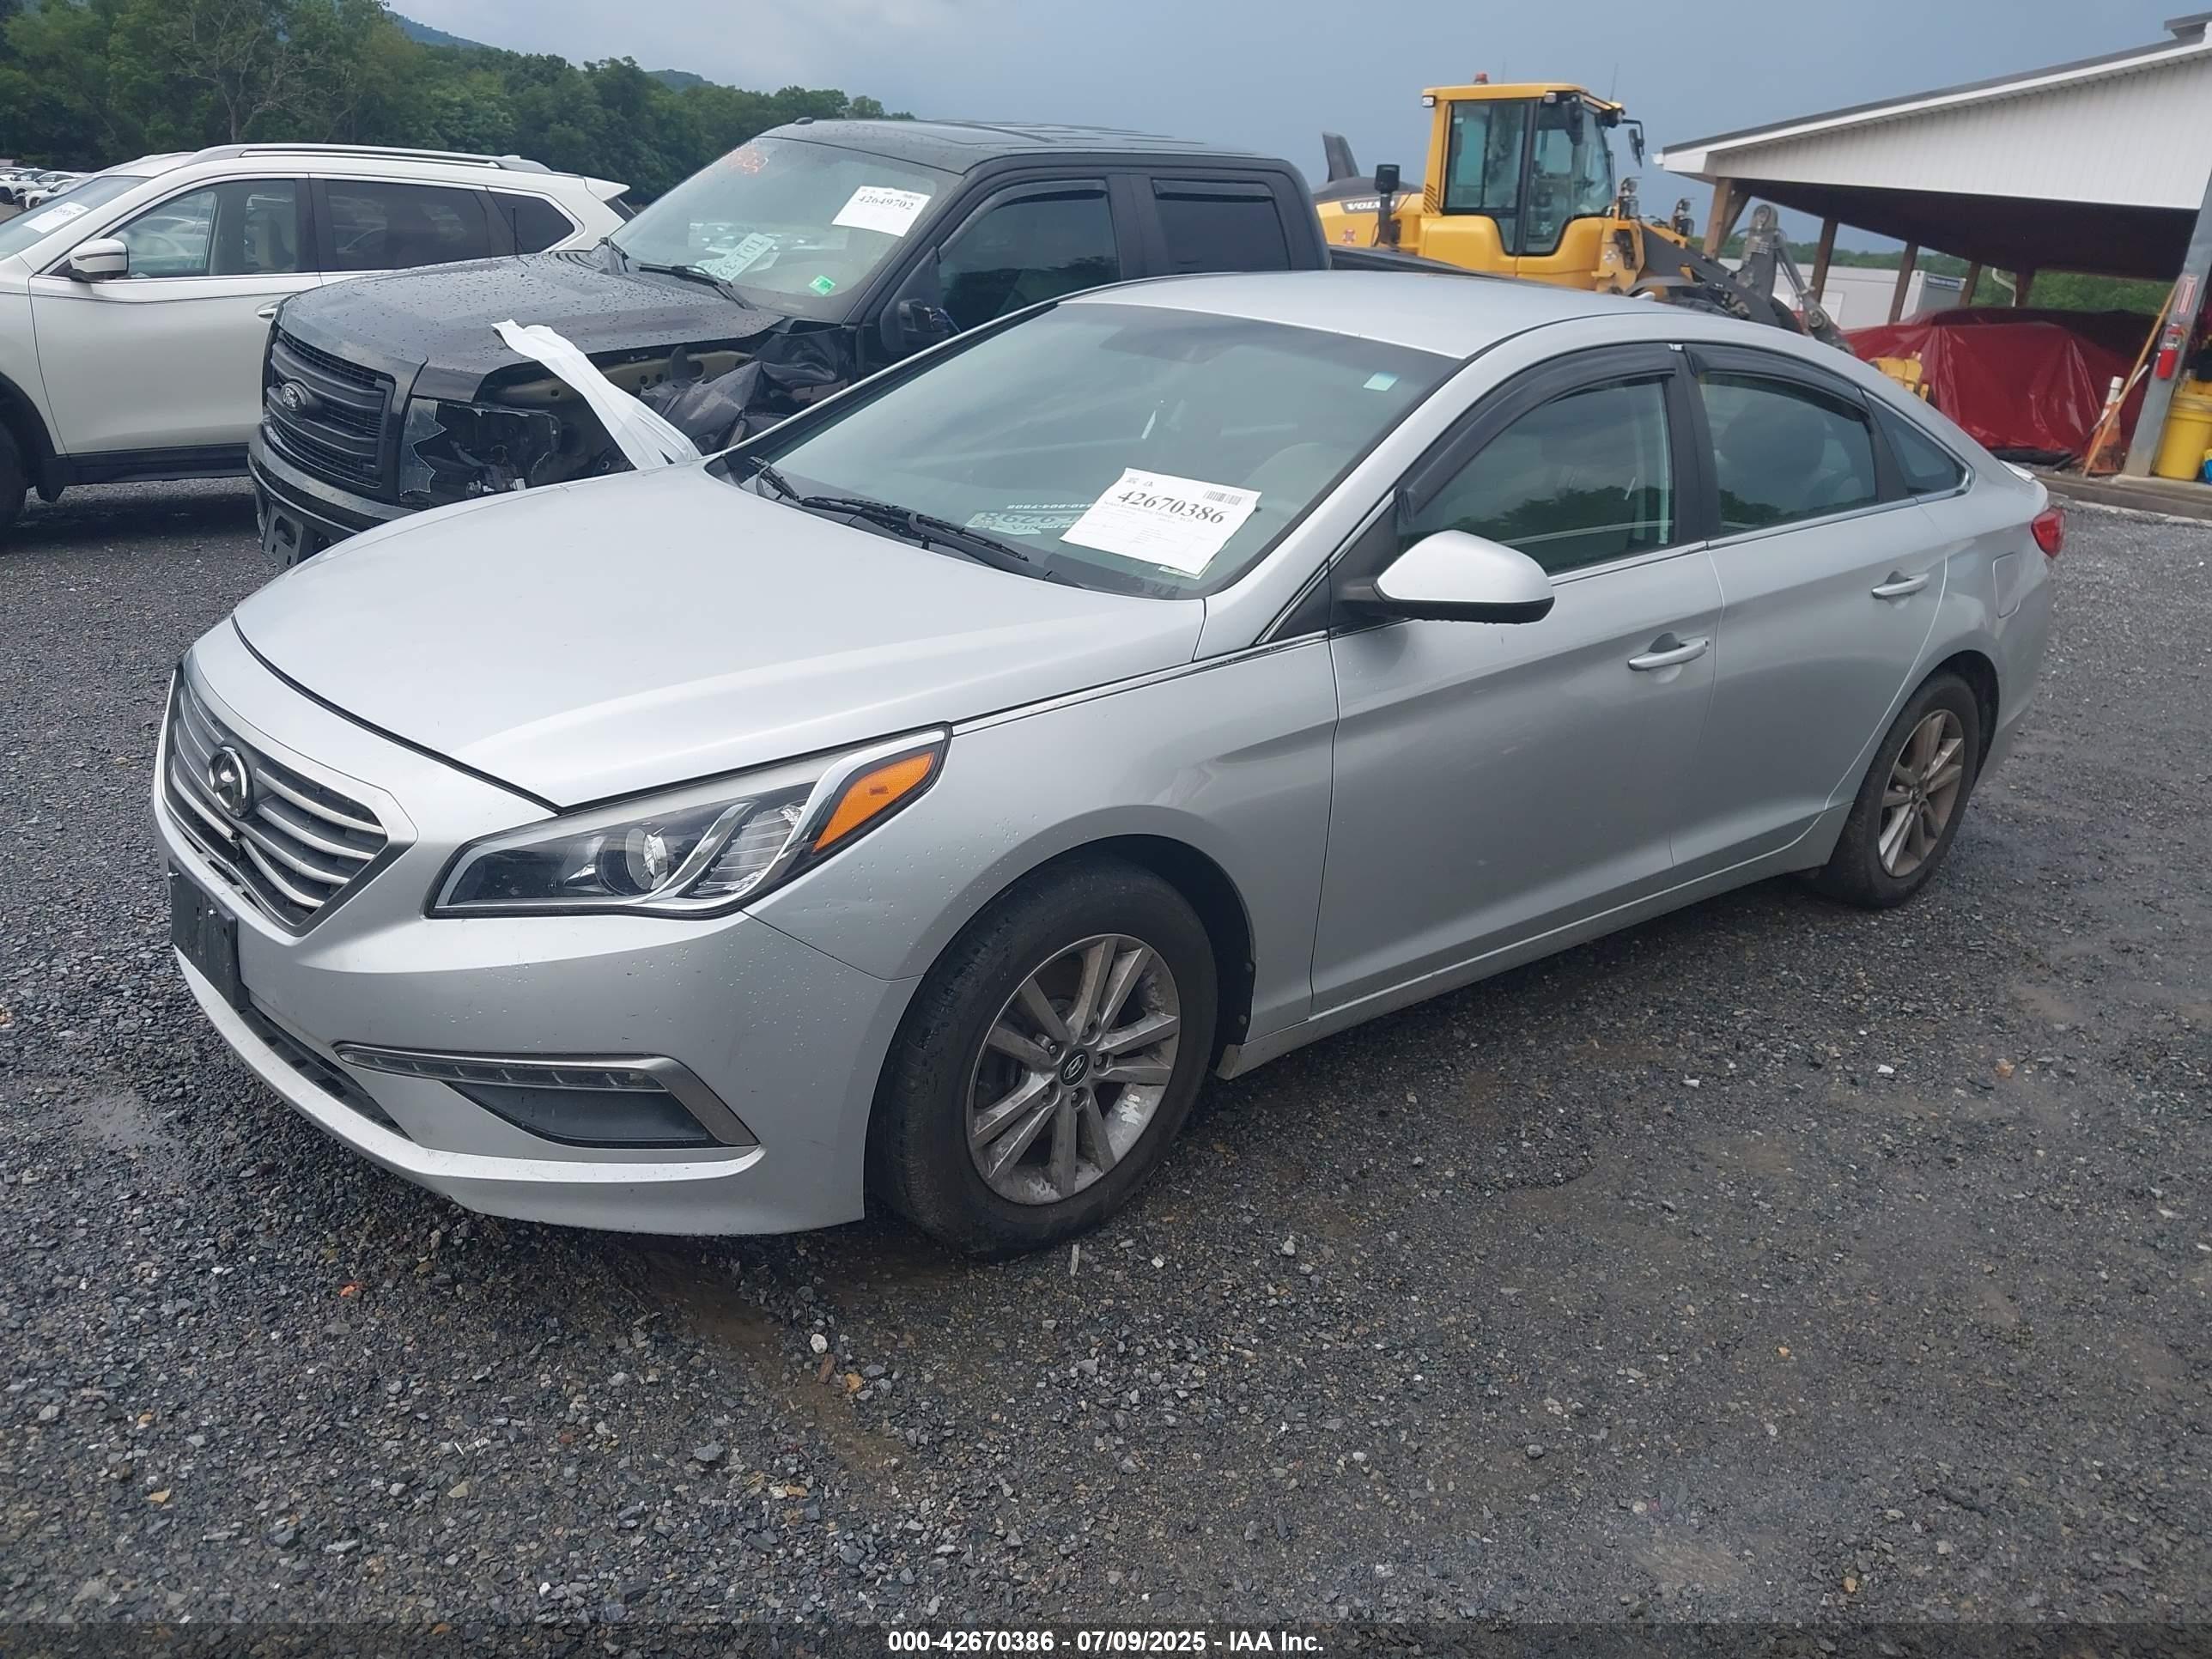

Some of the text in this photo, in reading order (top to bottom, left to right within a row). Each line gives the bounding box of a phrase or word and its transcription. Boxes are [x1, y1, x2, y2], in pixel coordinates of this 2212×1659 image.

[859, 195, 915, 210] 42649702
[283, 387, 299, 408] Ford
[1117, 490, 1230, 524] 42670386
